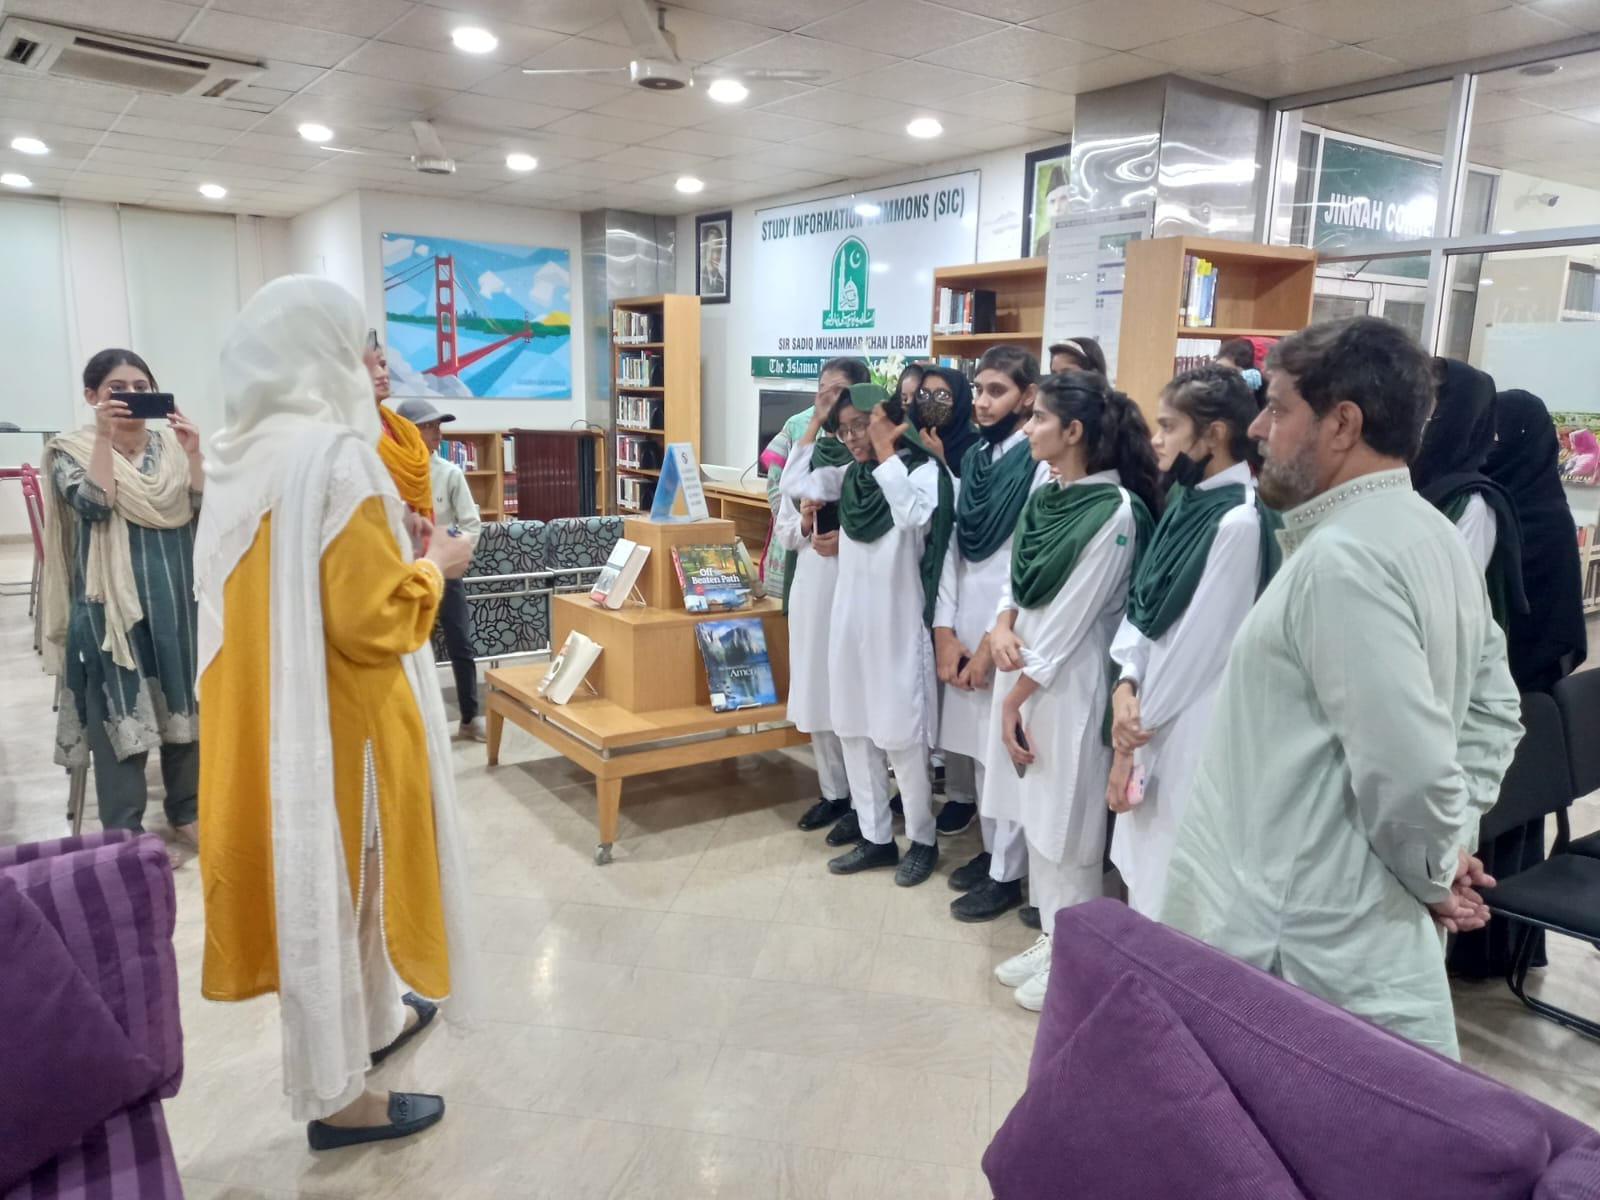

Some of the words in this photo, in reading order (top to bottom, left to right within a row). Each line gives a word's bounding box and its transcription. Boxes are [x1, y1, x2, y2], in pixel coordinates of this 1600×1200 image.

[761, 215, 790, 241] STUDY
[867, 193, 930, 227] MMONS
[934, 187, 965, 222] (SIC)
[1324, 192, 1383, 230] JINNAH
[778, 338, 790, 351] SIR
[791, 337, 813, 352] SADIQ
[890, 334, 929, 350] LIBRARY
[769, 358, 784, 373] The
[691, 576, 720, 585] Beaten
[720, 574, 741, 584] Path
[699, 568, 713, 577] Off
